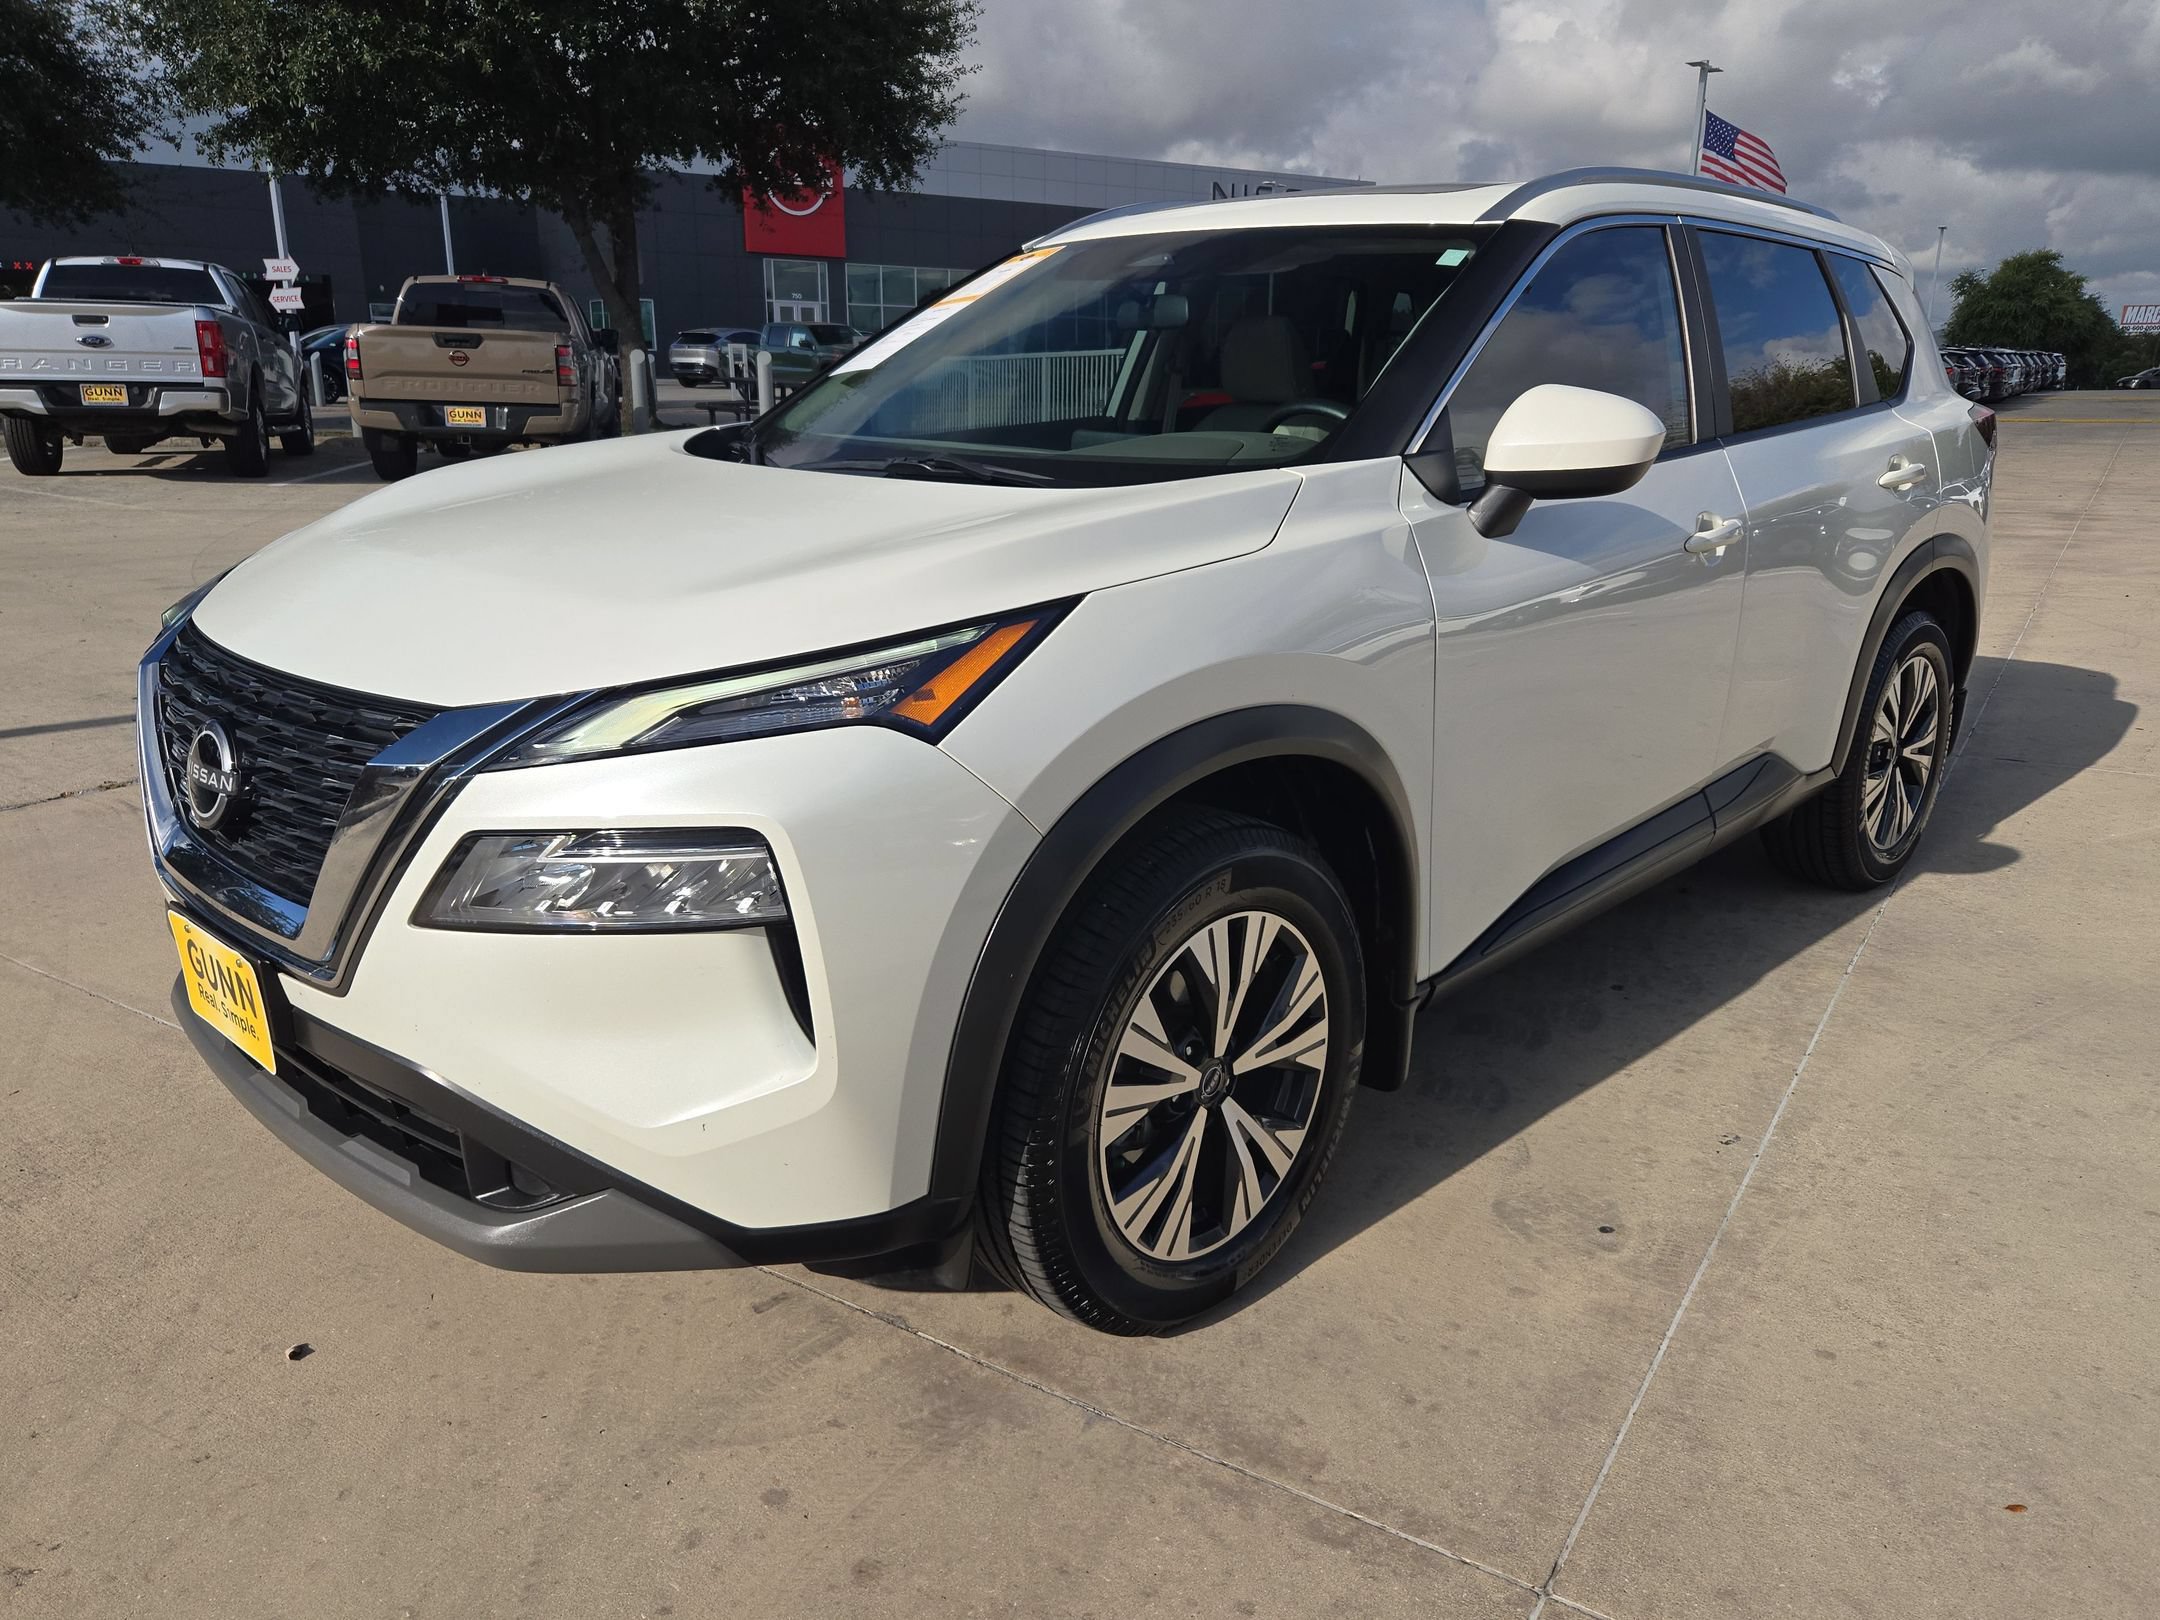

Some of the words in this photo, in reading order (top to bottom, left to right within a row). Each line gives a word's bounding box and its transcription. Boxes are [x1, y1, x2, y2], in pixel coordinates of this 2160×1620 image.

[272, 295, 299, 303] SERVICE
[0, 357, 196, 372] RANGER
[85, 388, 122, 396] GUNN
[449, 411, 482, 419] GUNN
[190, 761, 233, 792] ISSAN
[1216, 878, 1226, 891] 18
[187, 939, 258, 1019] GUNN
[198, 982, 221, 1013] Real.
[220, 1001, 260, 1041] Simple.
